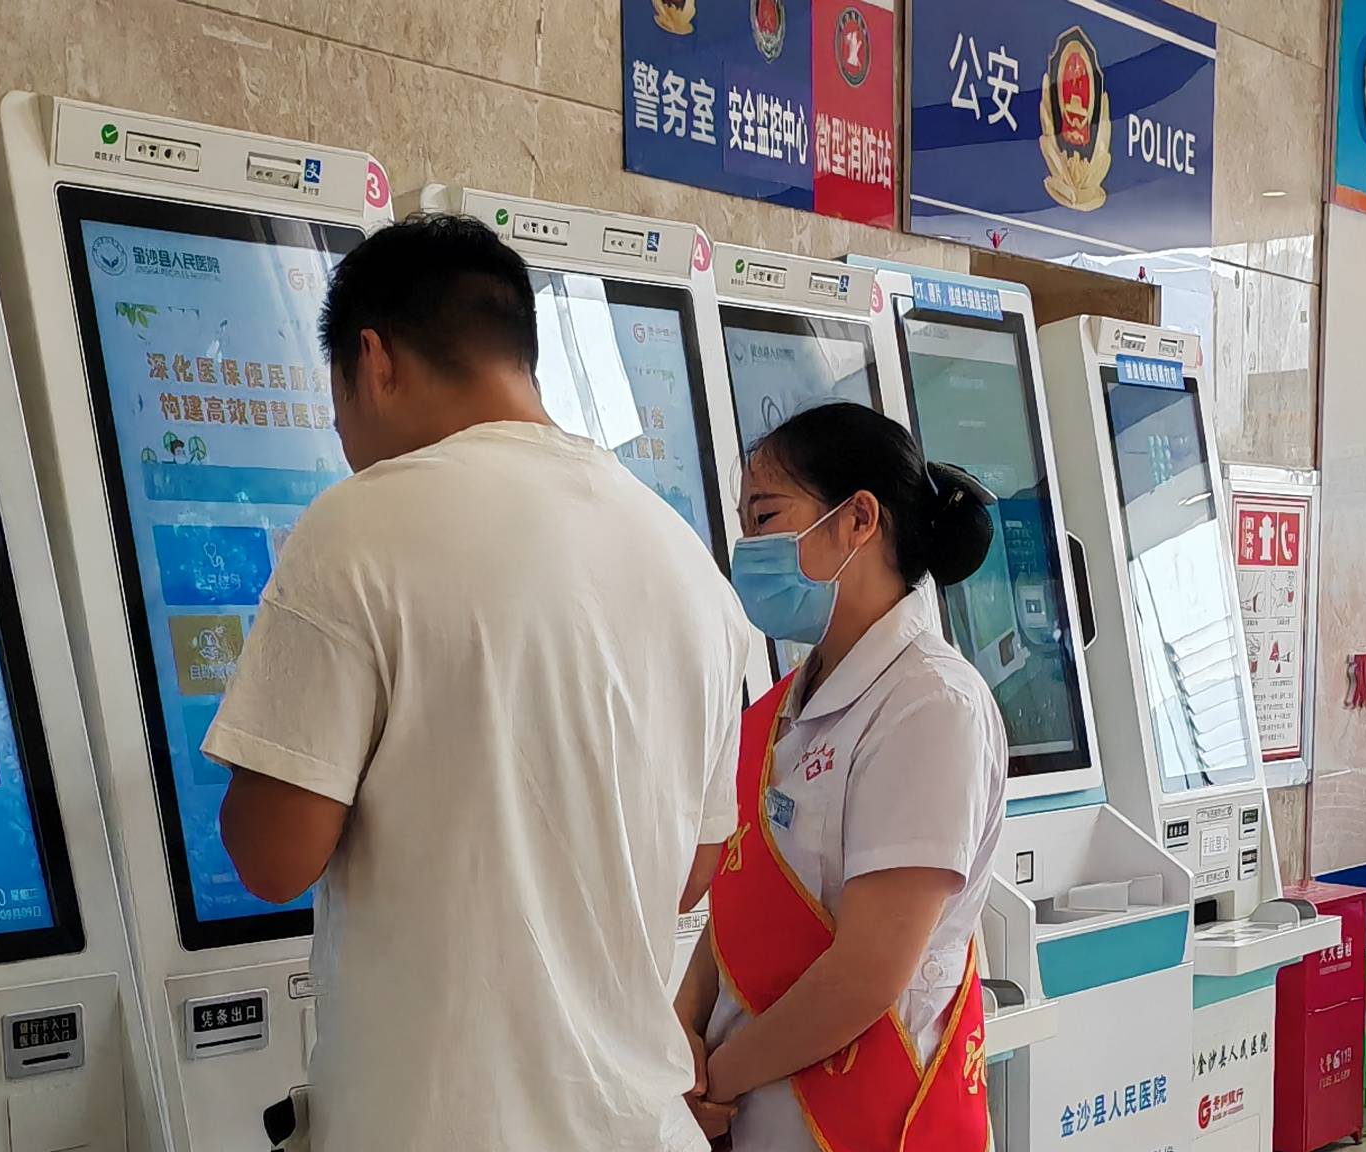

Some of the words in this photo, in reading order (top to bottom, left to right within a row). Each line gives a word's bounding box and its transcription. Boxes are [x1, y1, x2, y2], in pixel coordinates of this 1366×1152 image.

[632, 59, 716, 146] 警务室
[948, 33, 1021, 132] 公安
[728, 86, 809, 166] 安全监控中心
[815, 113, 892, 188] 微型消防站
[1128, 114, 1196, 175] POLICE
[366, 172, 381, 201] 3
[132, 247, 220, 274] 金沙县人民医院
[201, 1005, 258, 1028] 凭条出口
[1196, 1031, 1269, 1077] 金沙县人民医院
[1060, 1074, 1167, 1138] 金沙县人民医院
